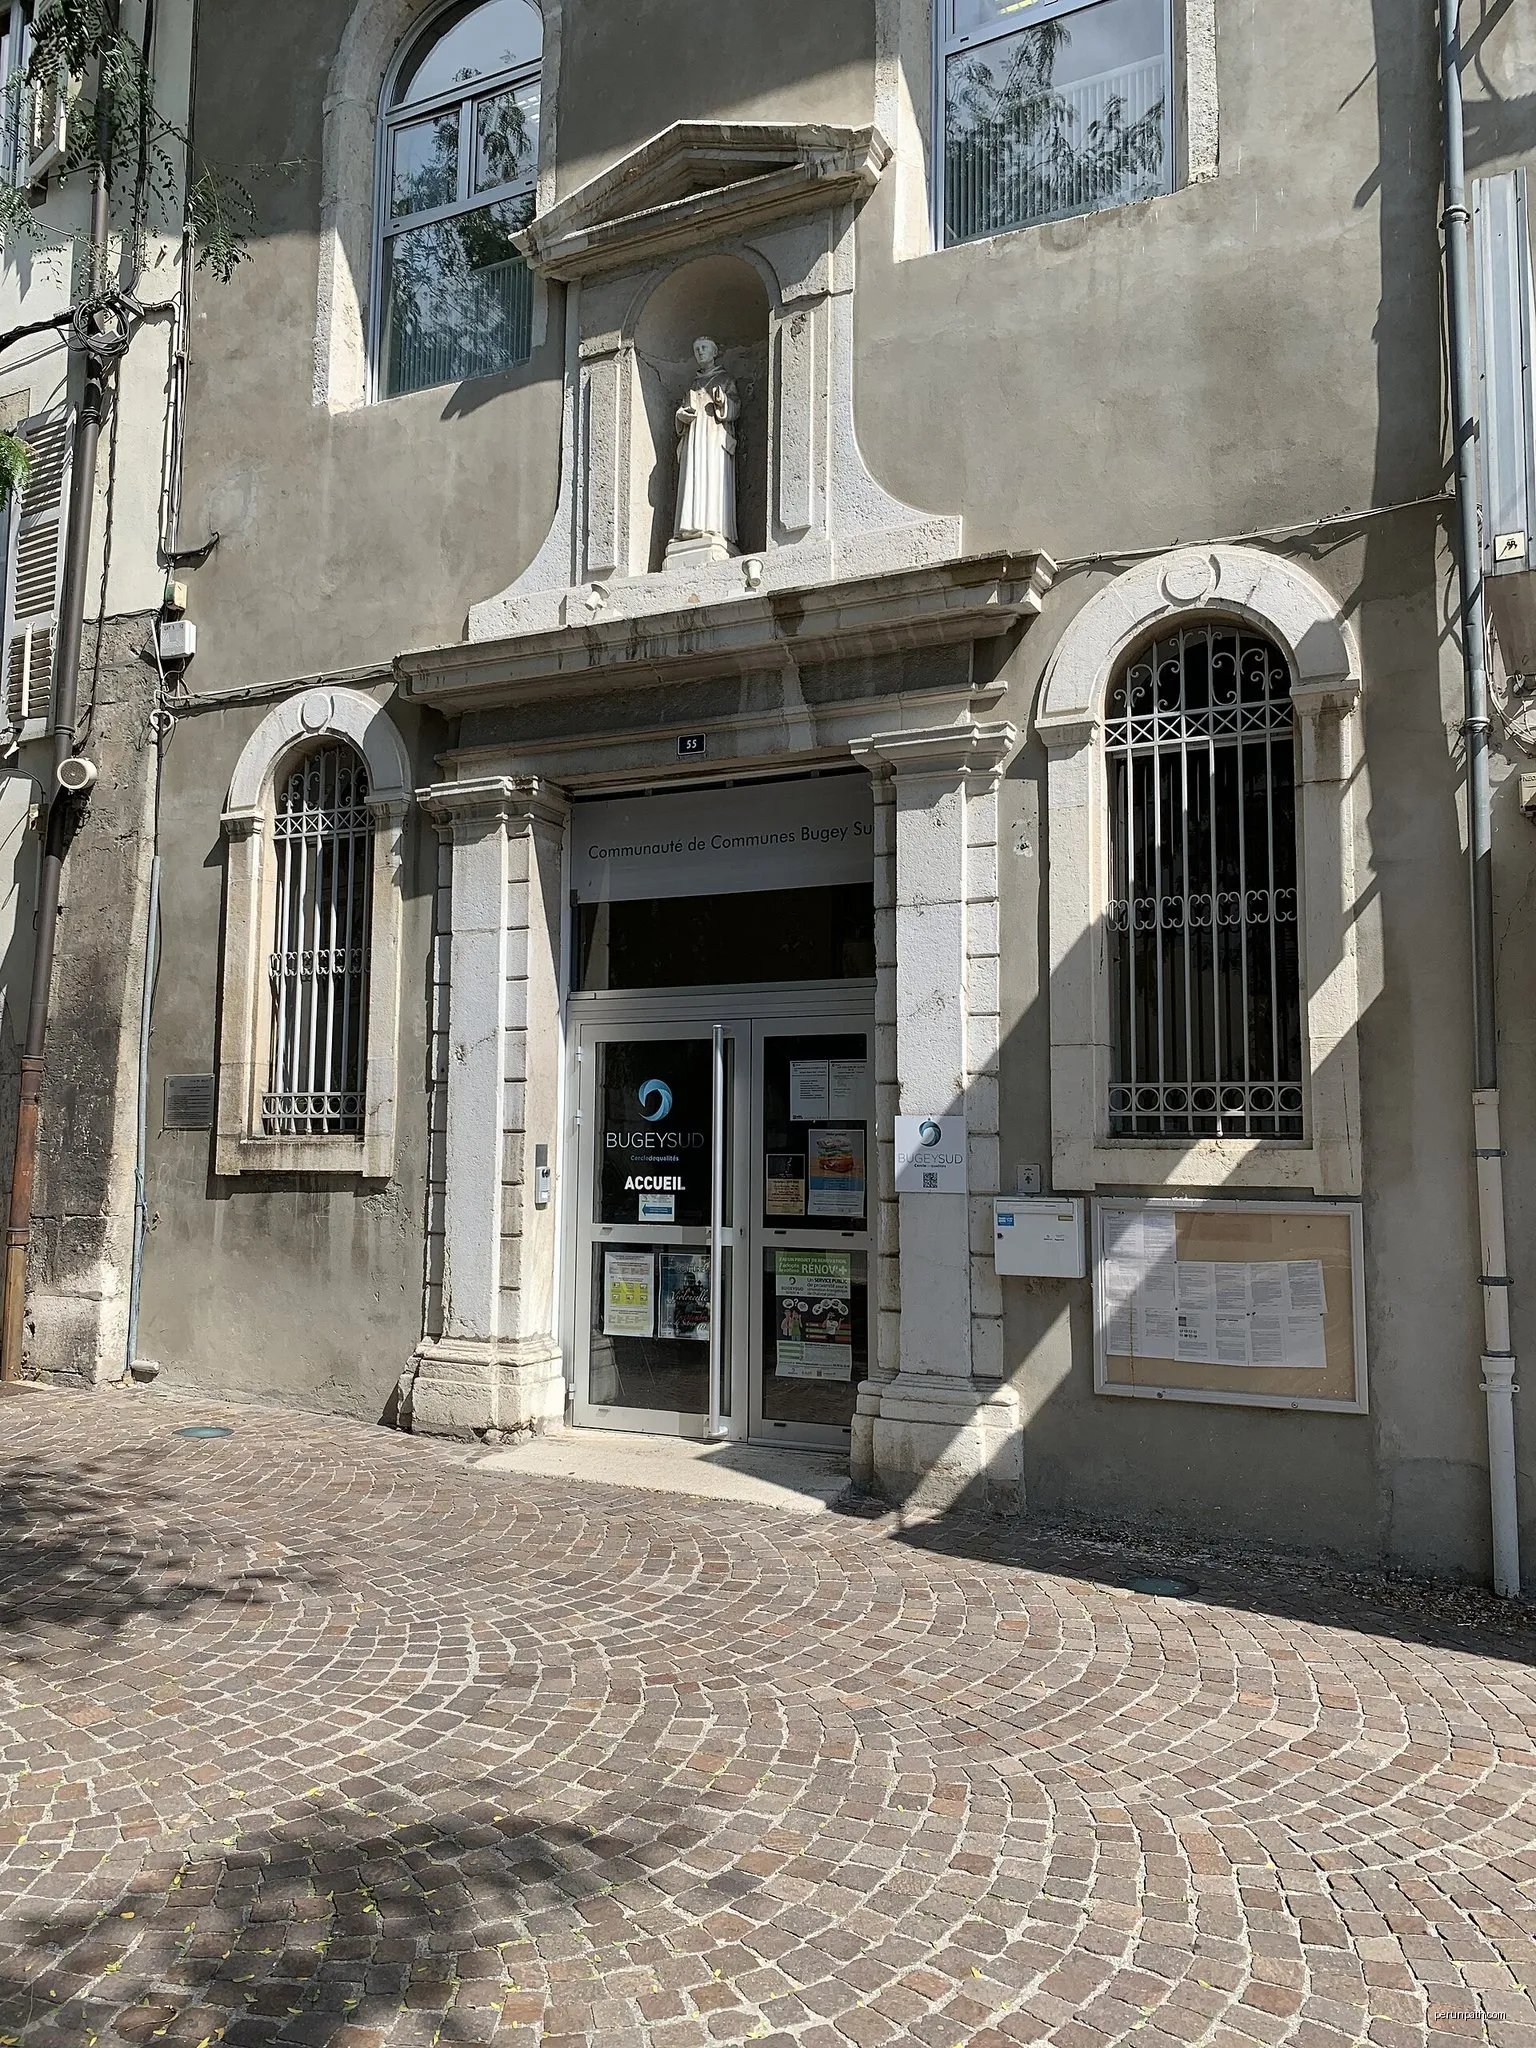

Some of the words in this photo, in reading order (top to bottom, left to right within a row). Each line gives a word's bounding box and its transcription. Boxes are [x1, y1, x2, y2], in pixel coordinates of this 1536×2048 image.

[686, 739, 697, 749] 55
[588, 838, 683, 859] Communauté
[688, 836, 706, 851] de
[711, 832, 795, 849] Communes
[801, 826, 848, 843] Bugey
[853, 821, 875, 836] Su
[606, 1132, 704, 1148] BUGEYSUD
[898, 1153, 963, 1164] BUGEYSUD
[624, 1176, 686, 1190] ACCUEIL
